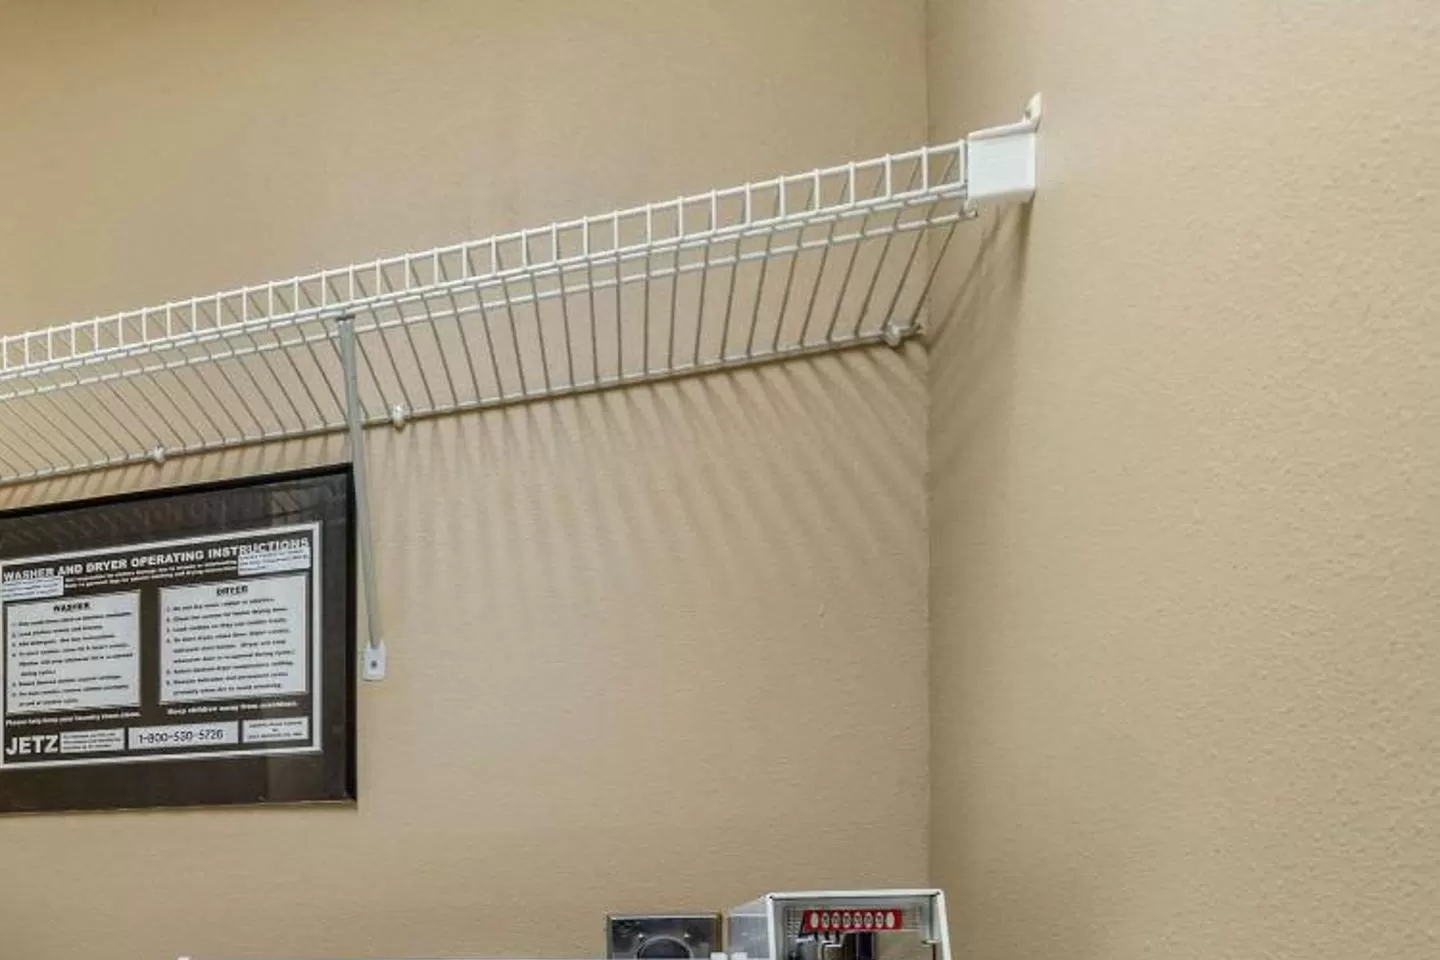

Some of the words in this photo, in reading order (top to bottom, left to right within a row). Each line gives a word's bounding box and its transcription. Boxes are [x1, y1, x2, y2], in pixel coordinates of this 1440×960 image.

[3, 568, 56, 581] WASHER
[58, 563, 83, 577] AND
[86, 559, 128, 573] DRYER
[131, 549, 205, 568] OPERATING
[209, 537, 310, 559] INSTRUCTIONS
[5, 734, 59, 756] JETZ
